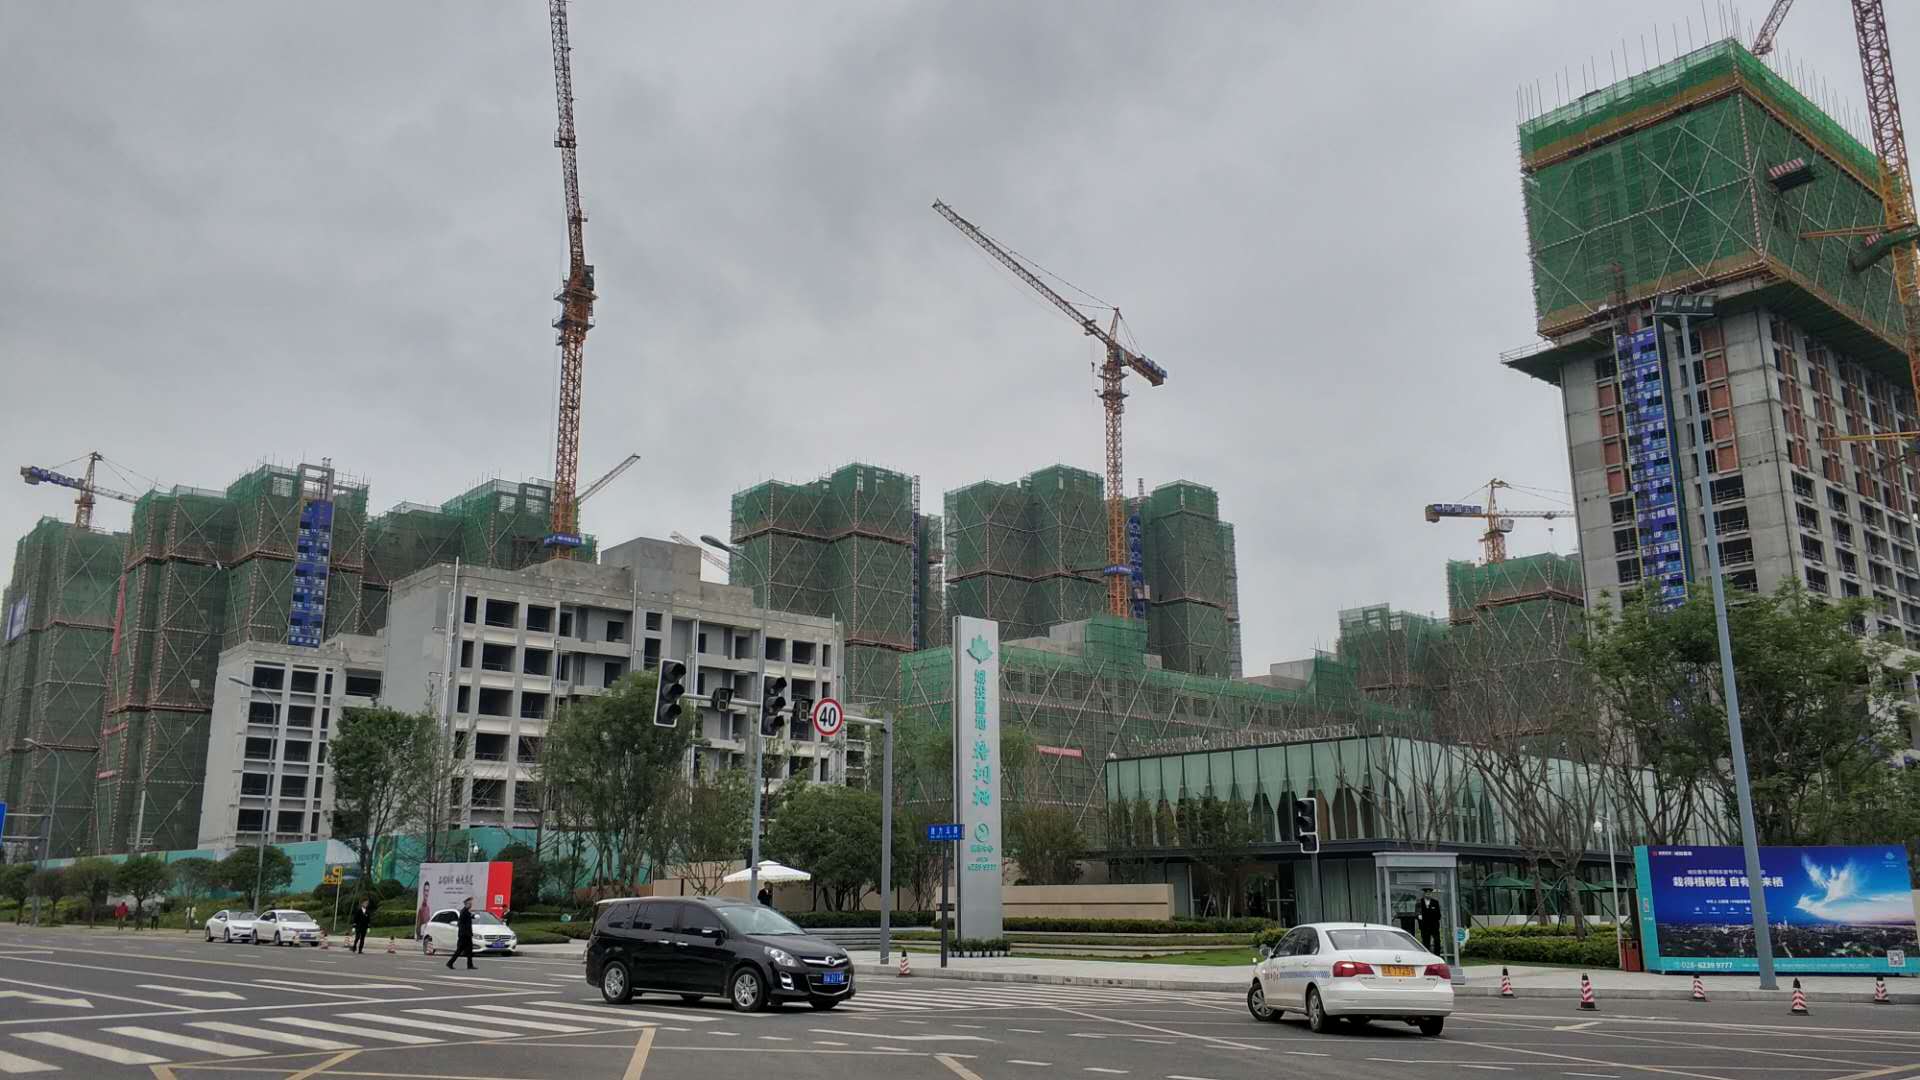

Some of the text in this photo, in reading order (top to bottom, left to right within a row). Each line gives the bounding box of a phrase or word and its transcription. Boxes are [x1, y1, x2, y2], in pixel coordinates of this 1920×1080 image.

[819, 706, 837, 727] 40
[1730, 877, 1784, 888] 自有来栖
